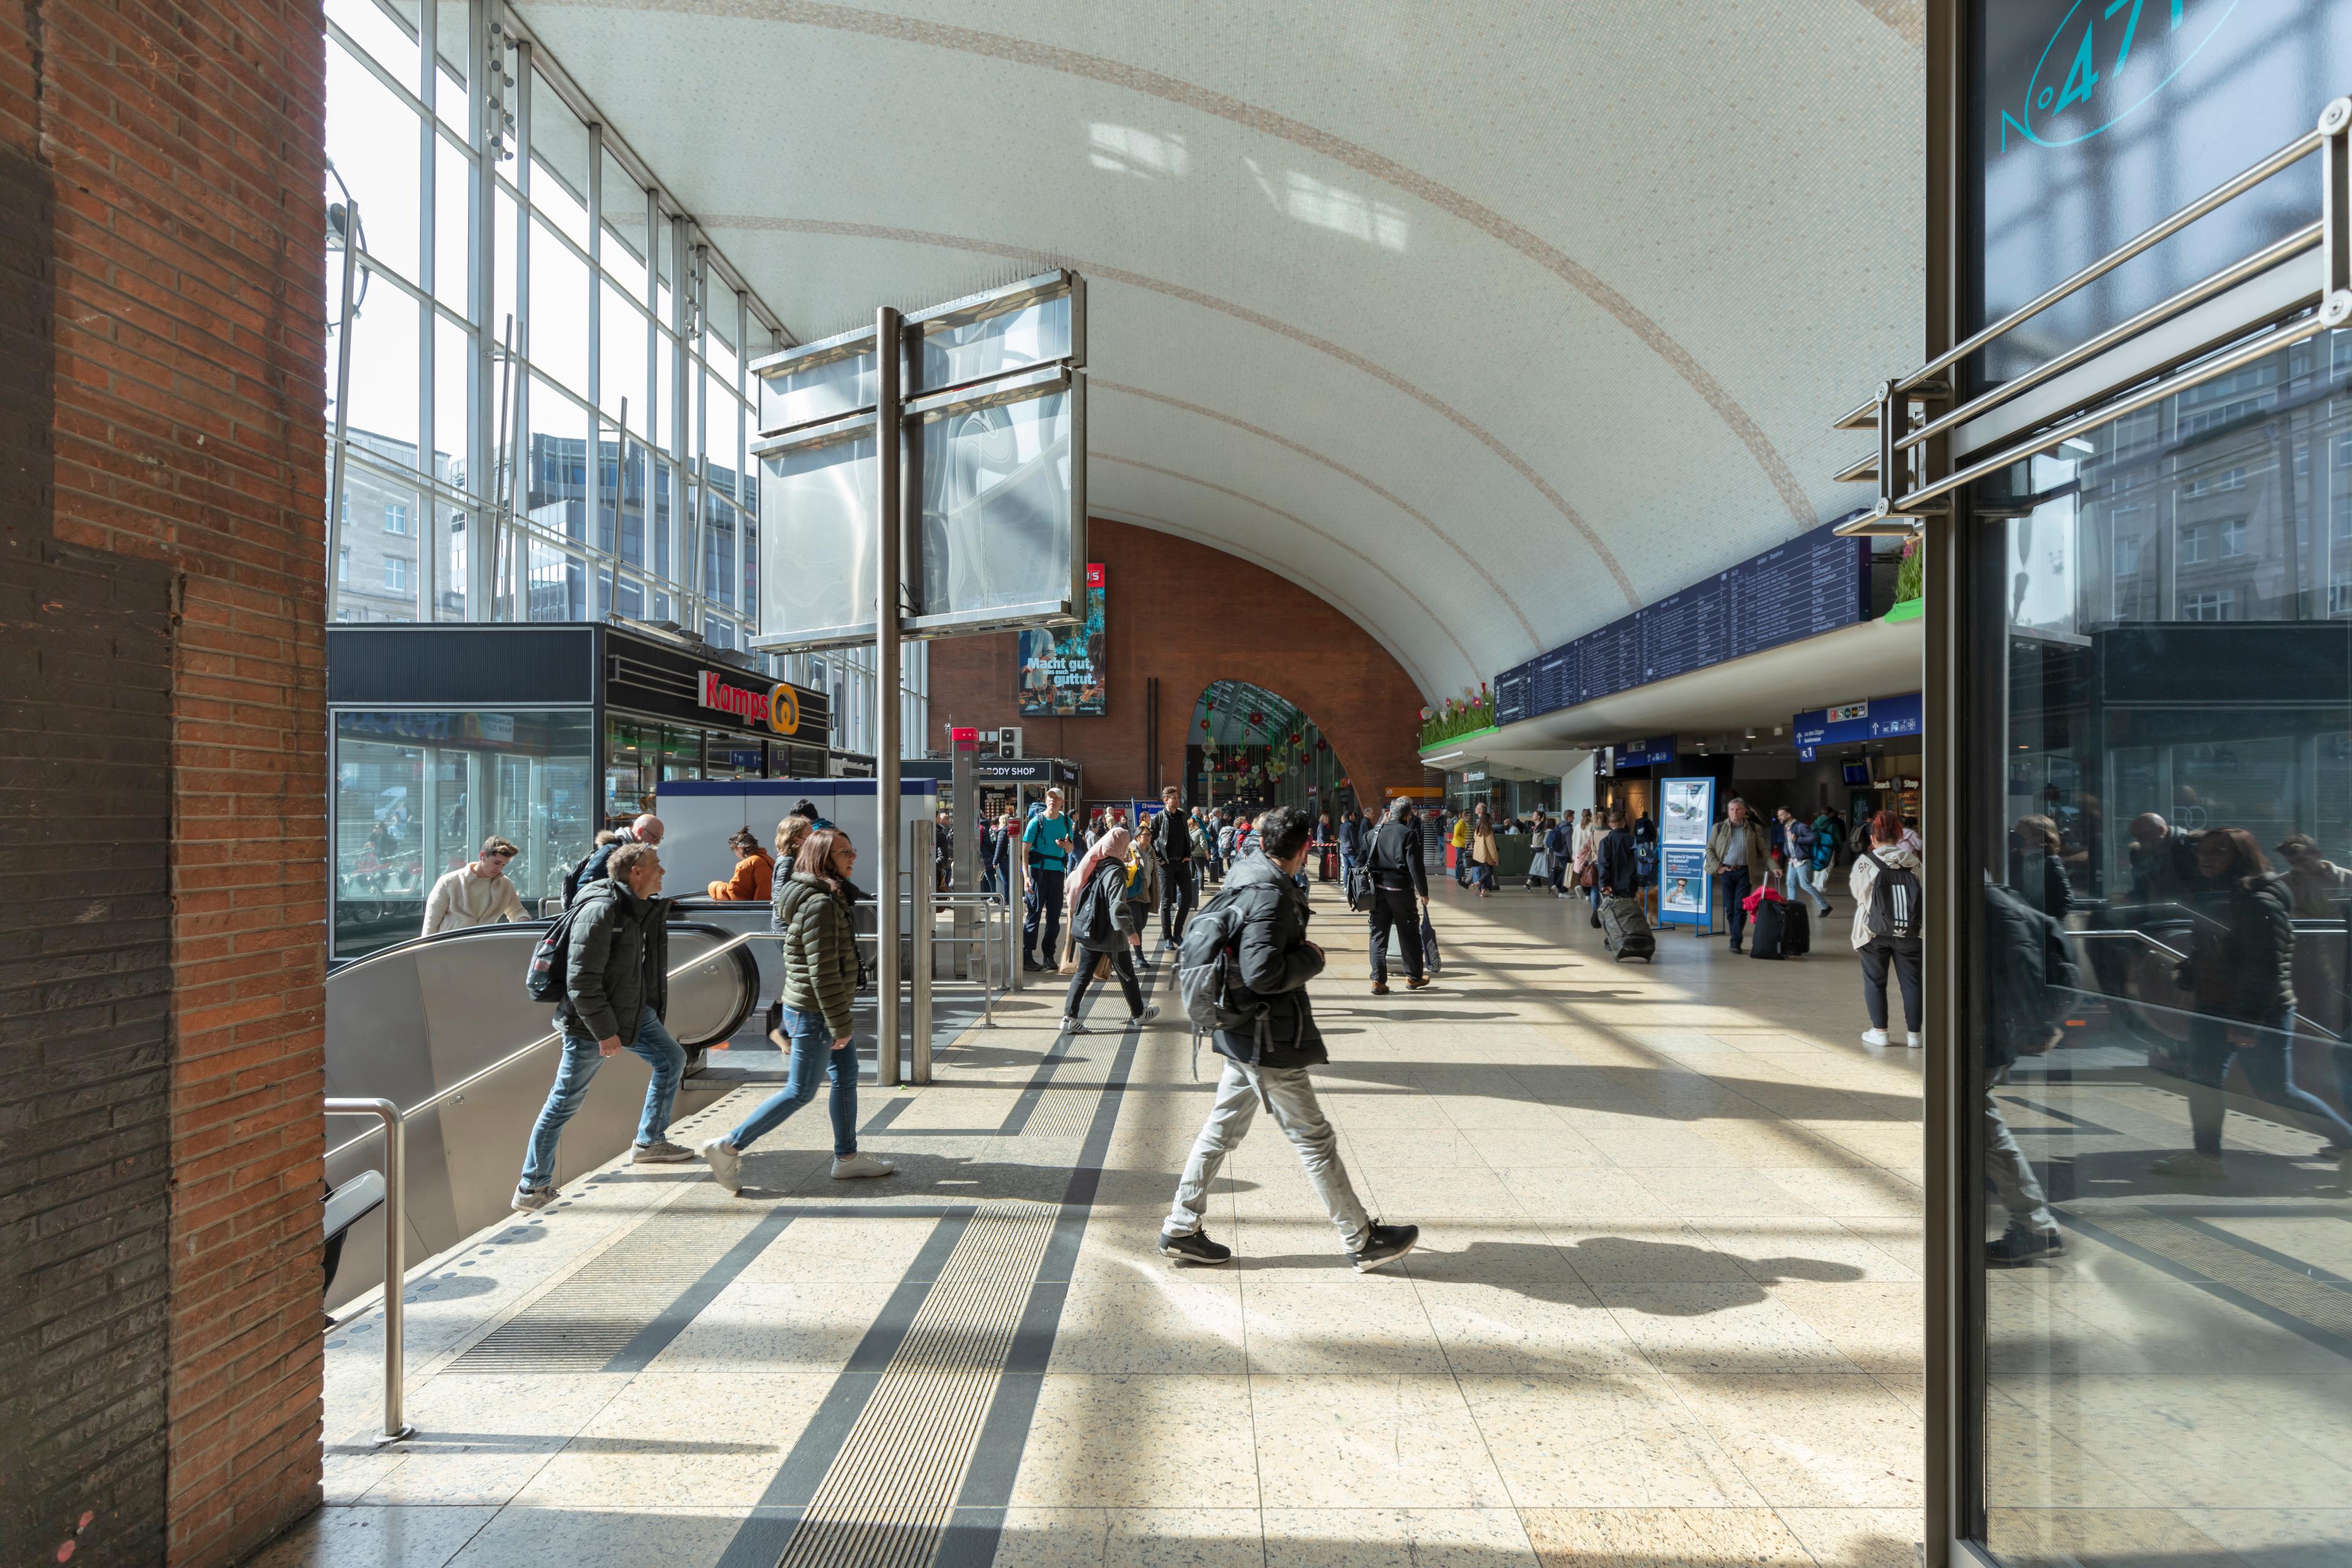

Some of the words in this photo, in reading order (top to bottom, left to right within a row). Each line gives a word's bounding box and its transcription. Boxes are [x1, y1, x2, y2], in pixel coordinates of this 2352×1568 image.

[1027, 657, 1066, 669] Macht
[1068, 658, 1095, 671] gut,
[1054, 673, 1096, 687] guttut.
[704, 671, 769, 725] Kamps
[1468, 771, 1485, 782] Information
[1904, 779, 1919, 788] Stop
